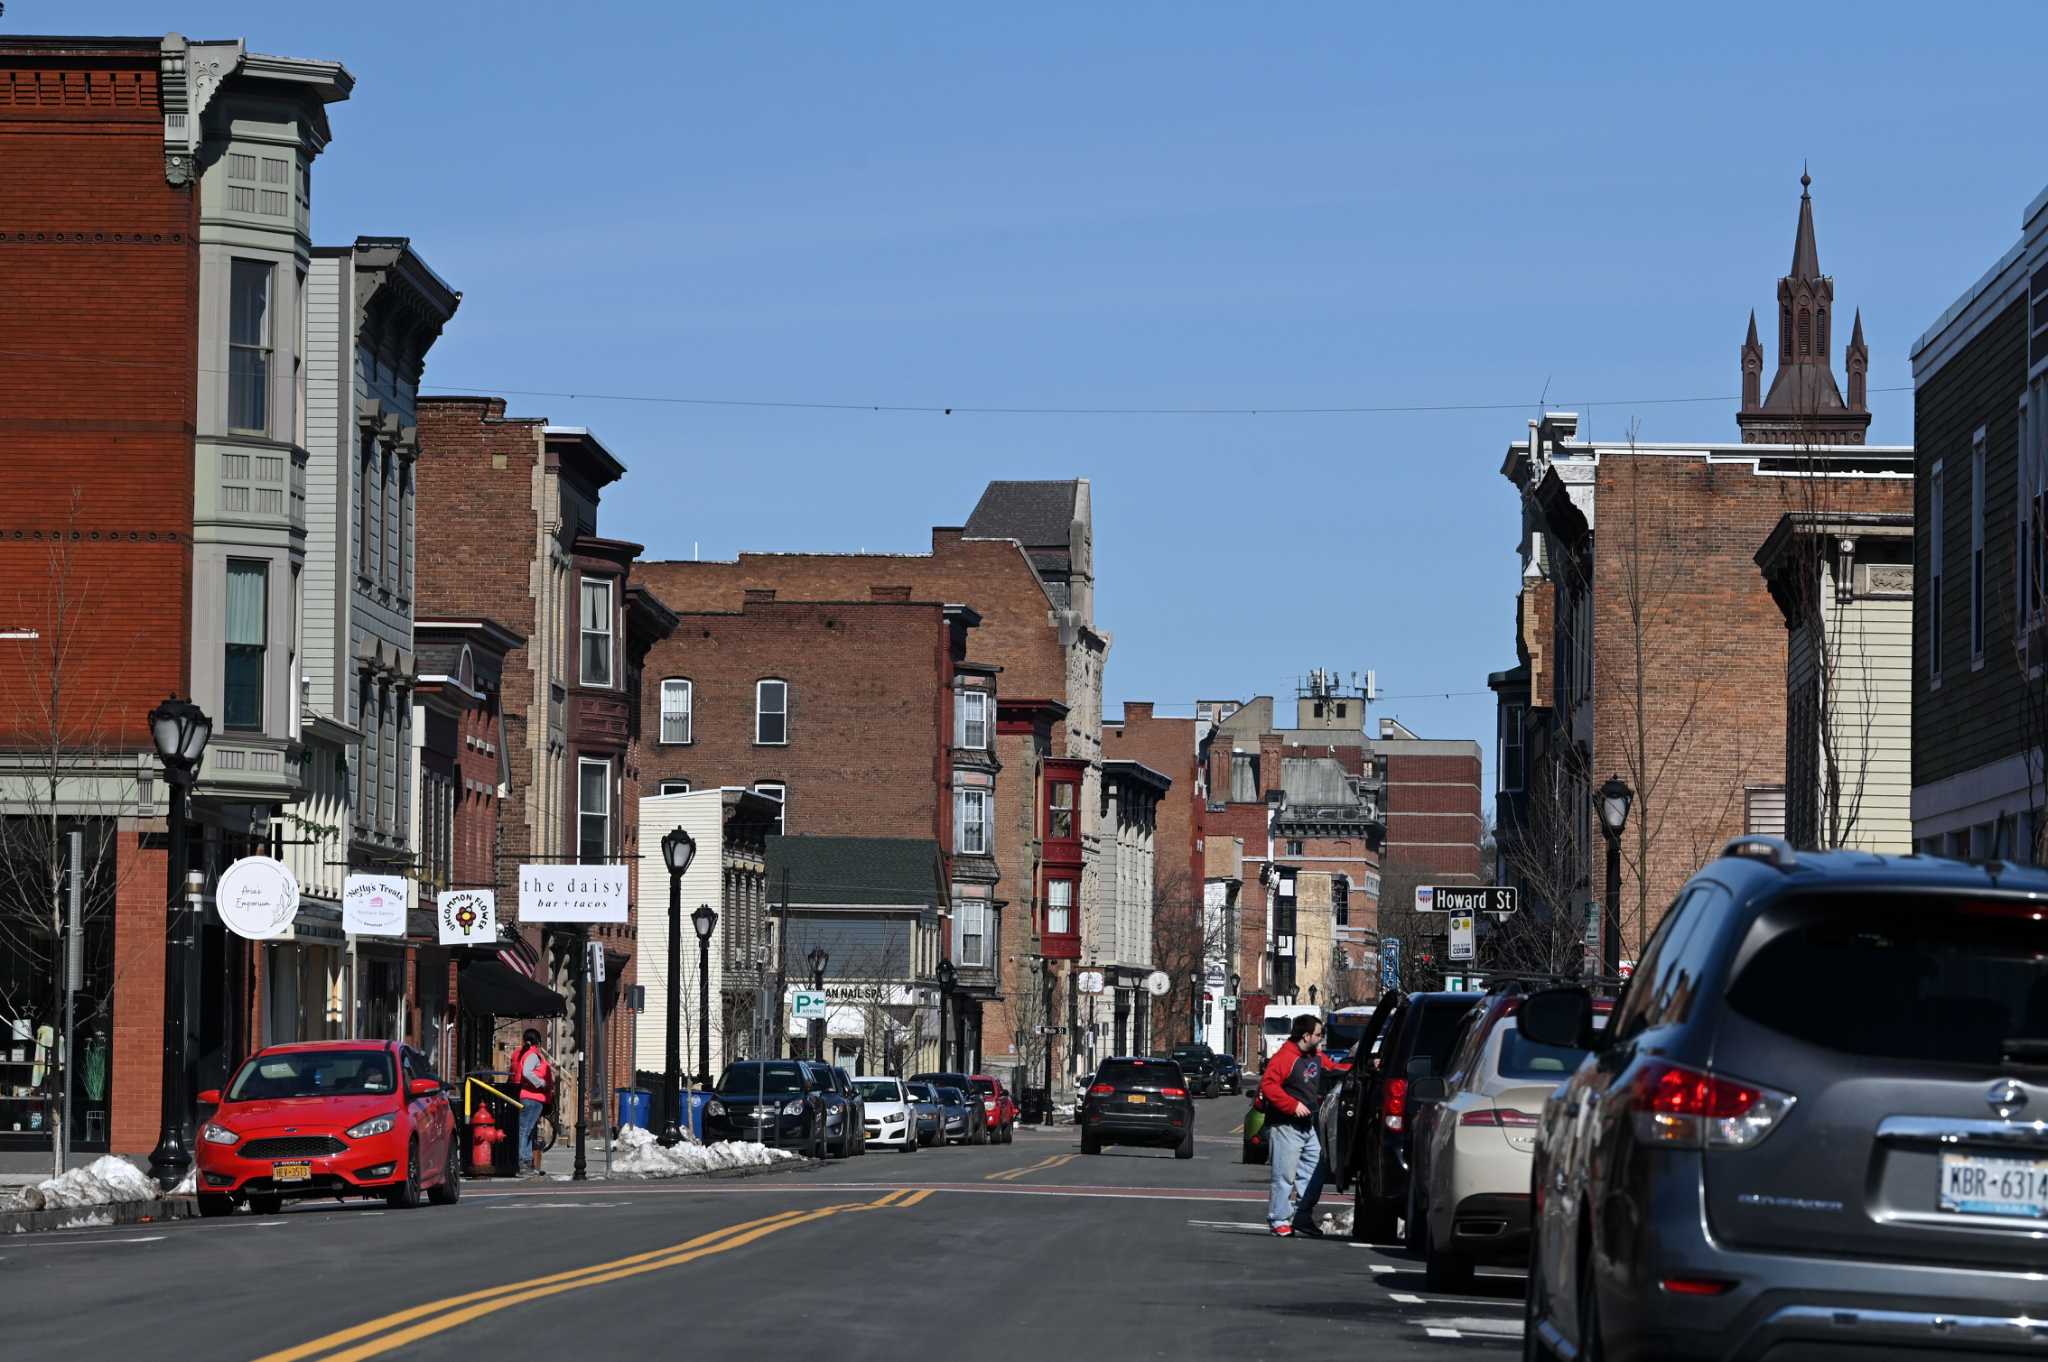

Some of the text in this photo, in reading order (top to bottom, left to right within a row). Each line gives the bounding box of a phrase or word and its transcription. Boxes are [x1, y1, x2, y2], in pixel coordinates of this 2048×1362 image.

[379, 883, 403, 900] Treats
[523, 878, 623, 896] the daisy
[537, 899, 558, 908] bar
[573, 899, 608, 908] tacos
[1437, 890, 1511, 909] Howard St
[444, 894, 489, 931] UNCOMMON FLOWER
[840, 988, 861, 998] NAIL
[865, 988, 883, 998] SPA
